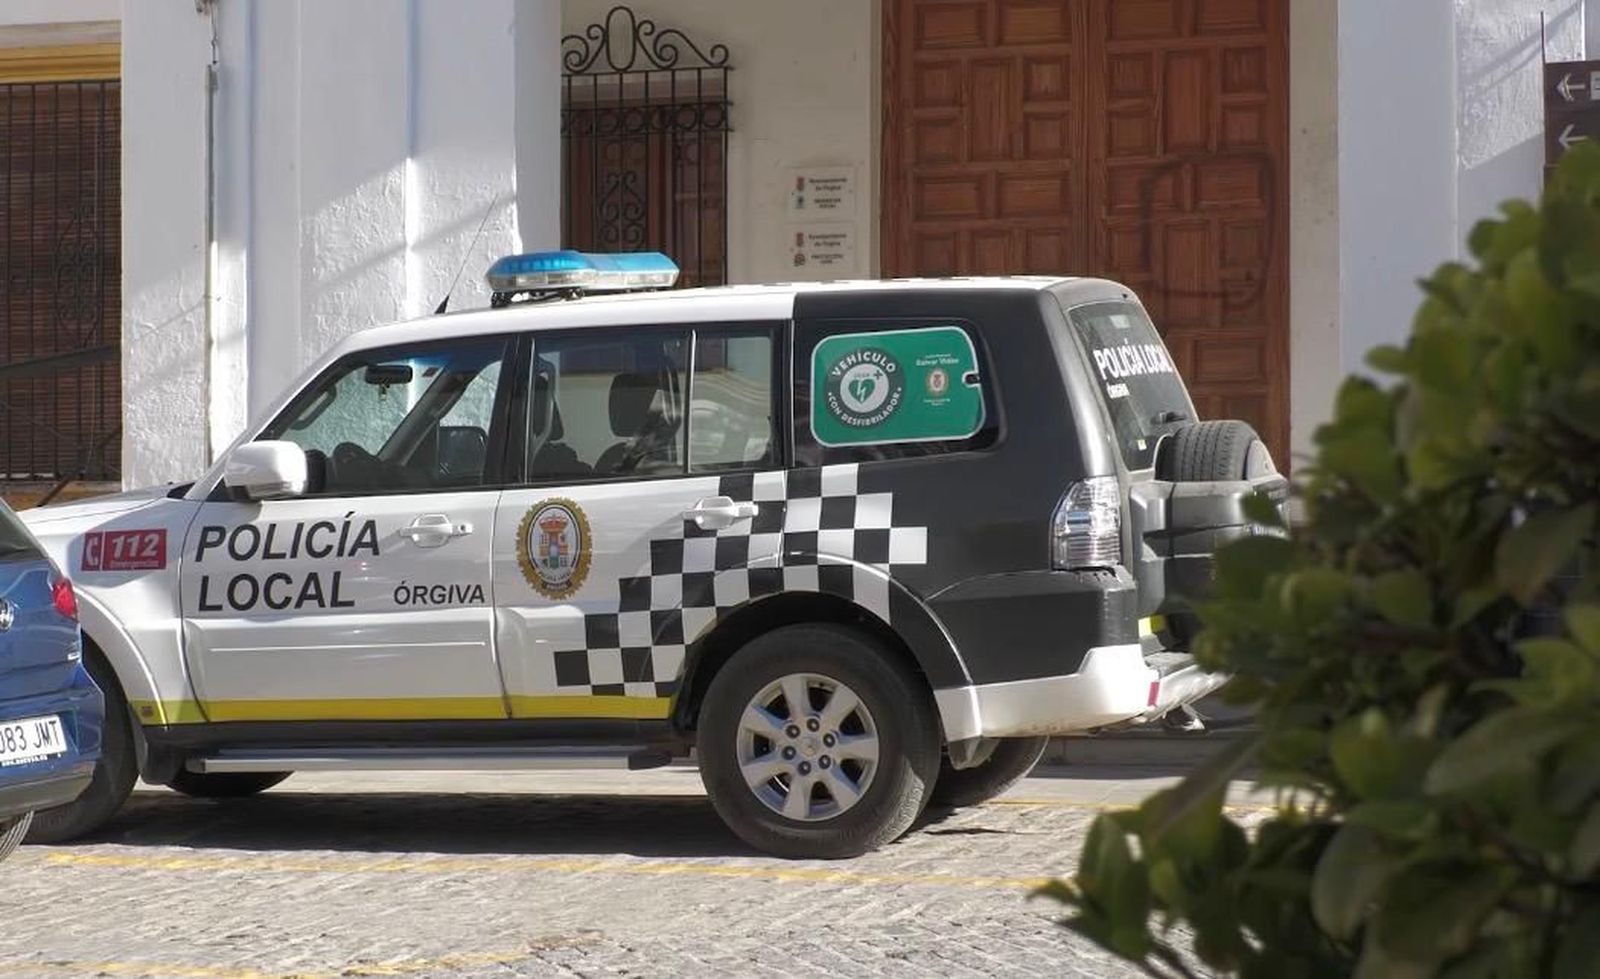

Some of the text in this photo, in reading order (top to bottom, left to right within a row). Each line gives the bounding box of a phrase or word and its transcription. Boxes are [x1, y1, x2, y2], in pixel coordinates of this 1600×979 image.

[828, 392, 900, 426] CON DESFIBRILADOR
[112, 533, 160, 560] 112
[195, 511, 380, 562] POLICÍA
[198, 571, 355, 612] LOCAL
[394, 580, 485, 605] ÓRGIVA
[33, 720, 60, 748] JMT
